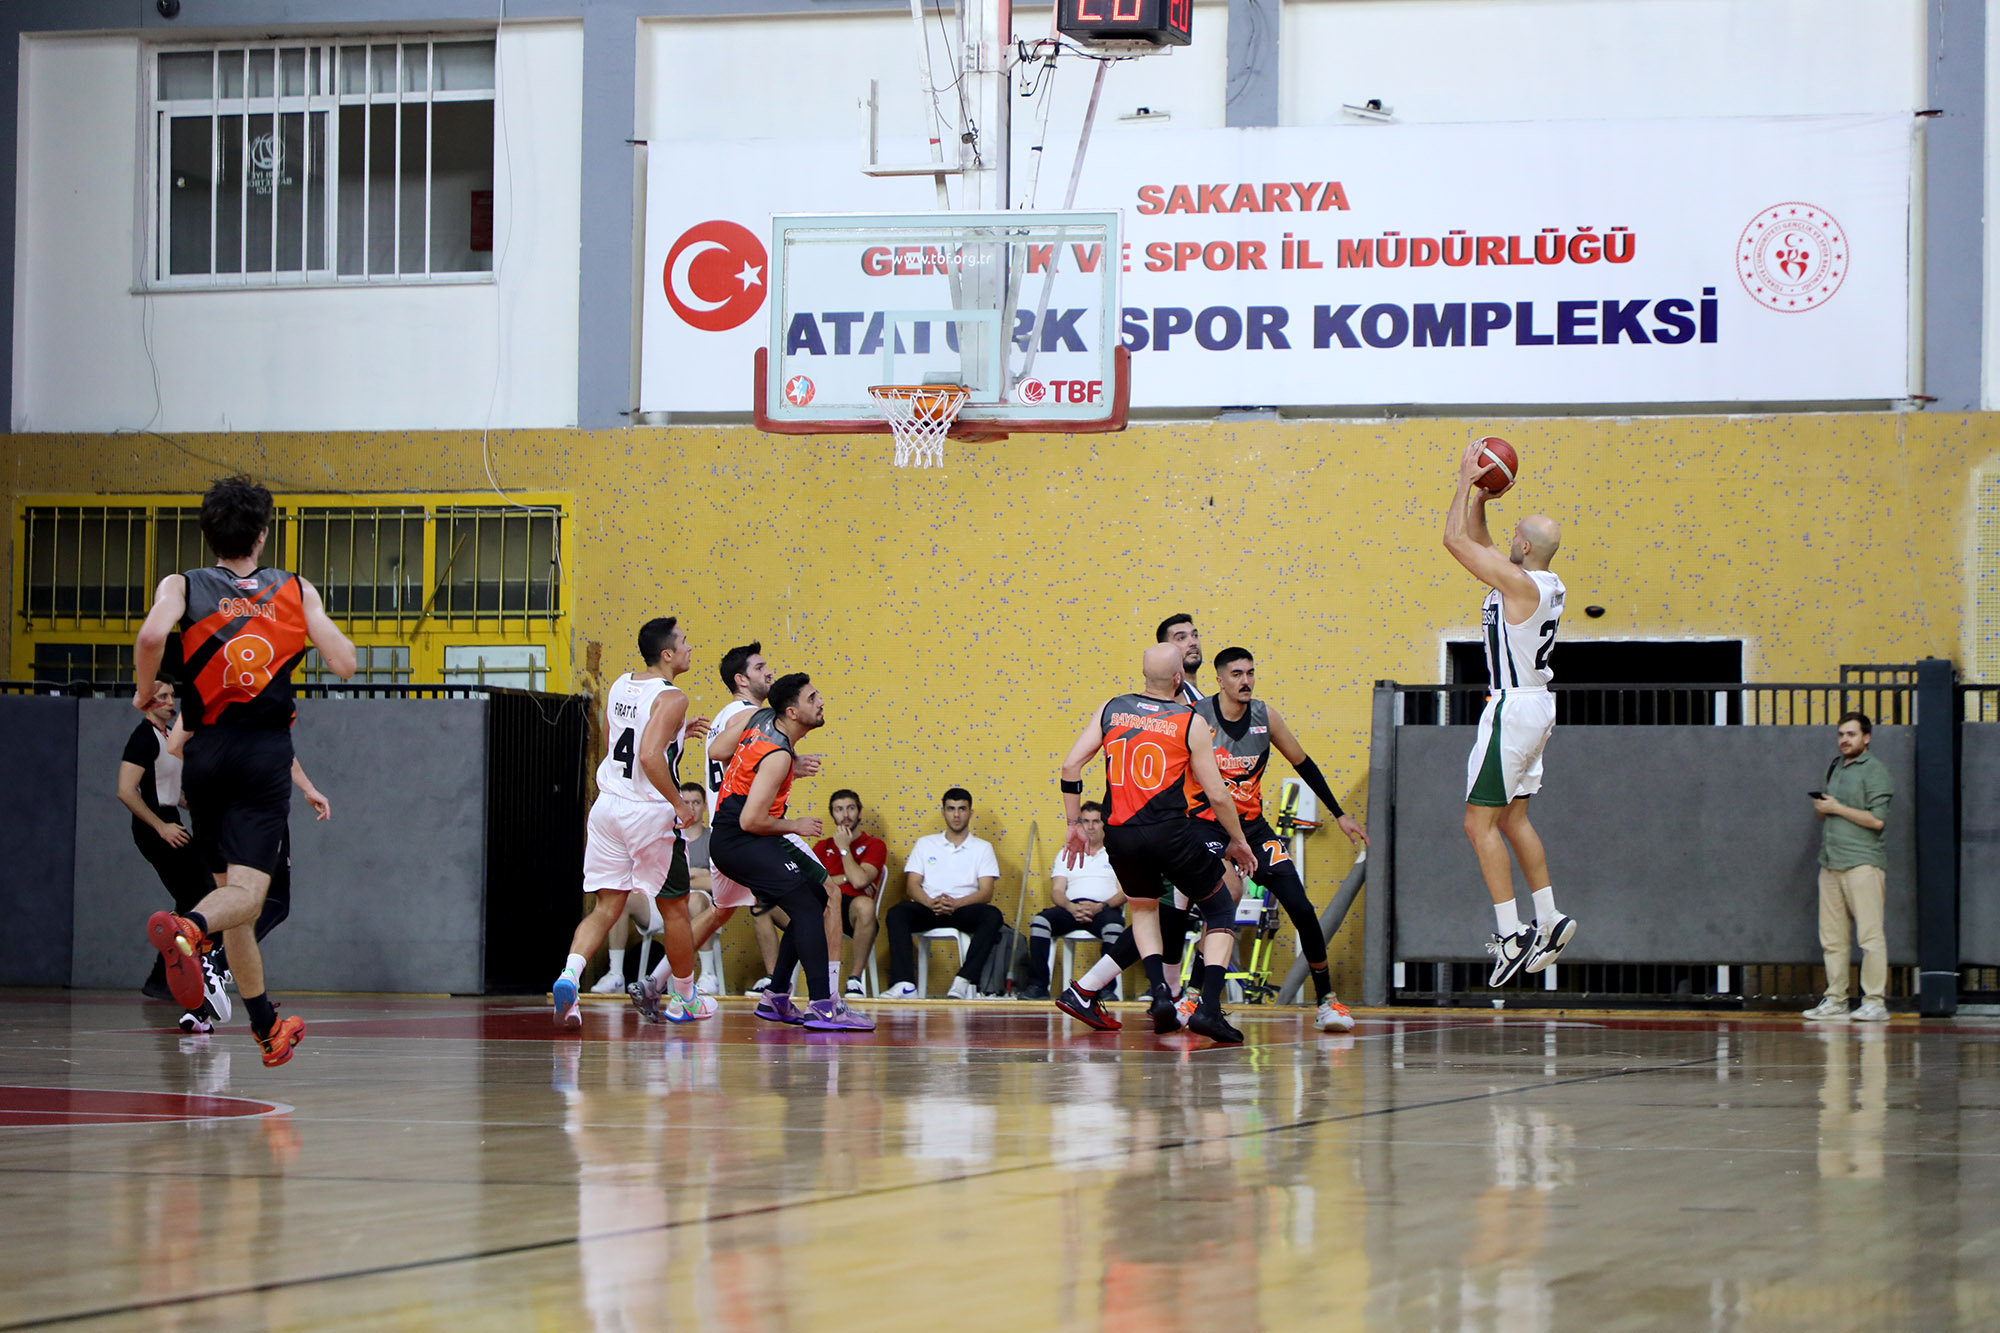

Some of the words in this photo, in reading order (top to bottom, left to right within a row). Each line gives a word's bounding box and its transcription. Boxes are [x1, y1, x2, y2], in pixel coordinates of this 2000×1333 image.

[1136, 181, 1351, 216] SAKARYA
[891, 251, 991, 267] www.tbf.org.tr
[1144, 240, 1268, 272] SPOR
[1281, 231, 1324, 270] İL
[1336, 226, 1636, 270] MÜDÜRLÜĞÜ
[1121, 304, 1293, 352] SPOR
[1312, 286, 1718, 350] KOMPLEKSİ
[1047, 380, 1103, 404] TBF
[223, 633, 275, 697] 8
[1109, 712, 1178, 738] BAYRAKTAR
[613, 727, 635, 780] 4
[1106, 737, 1167, 791] 10
